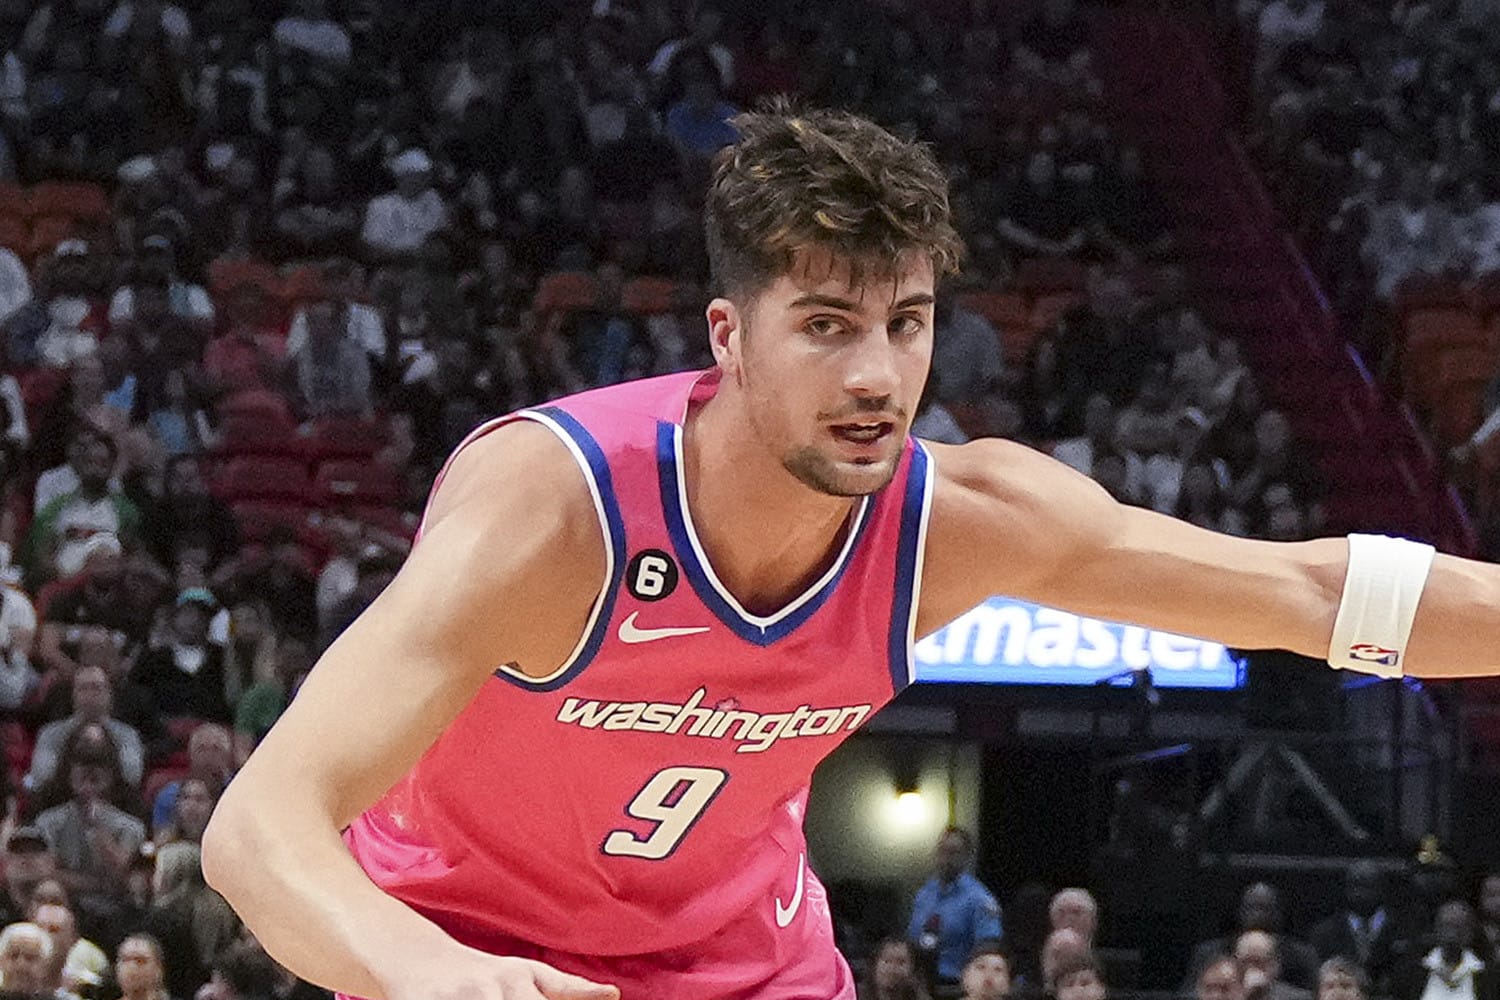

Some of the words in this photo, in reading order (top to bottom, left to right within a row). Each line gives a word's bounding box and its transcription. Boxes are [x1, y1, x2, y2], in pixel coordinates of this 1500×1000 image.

[634, 556, 669, 597] 6
[557, 686, 872, 754] washington
[602, 765, 729, 860] 9
